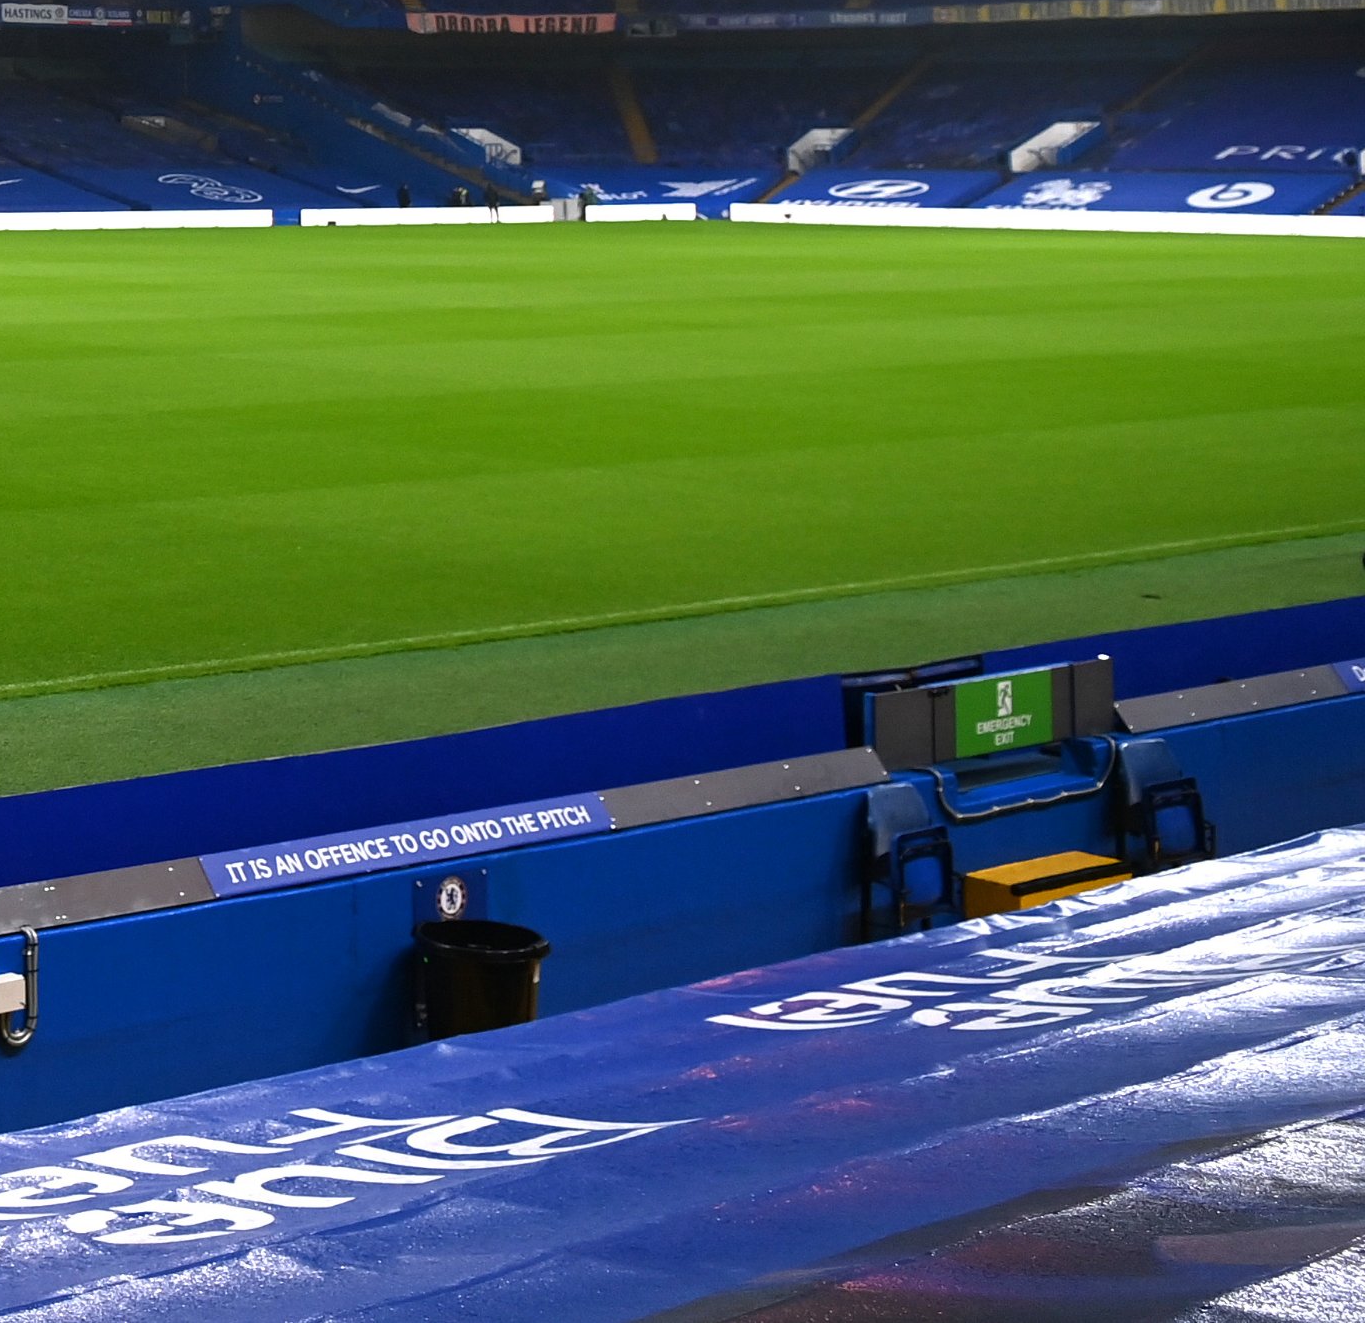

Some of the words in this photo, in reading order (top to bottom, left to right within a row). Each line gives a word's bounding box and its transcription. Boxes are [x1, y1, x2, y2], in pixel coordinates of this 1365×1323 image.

[4, 7, 52, 20] HASTINGS
[435, 14, 511, 33] DROGBA
[524, 15, 599, 33] LEGEND
[977, 714, 1031, 734] EMERGENCY
[996, 731, 1014, 745] EXIT
[225, 860, 248, 885] IT
[248, 857, 273, 881] IS
[275, 851, 305, 878] AN
[308, 836, 390, 872] OFFENCE
[389, 832, 419, 855] TO
[419, 826, 450, 850] GO
[450, 819, 504, 846] ONTO
[505, 813, 539, 838] THE
[537, 804, 592, 831] PITCH
